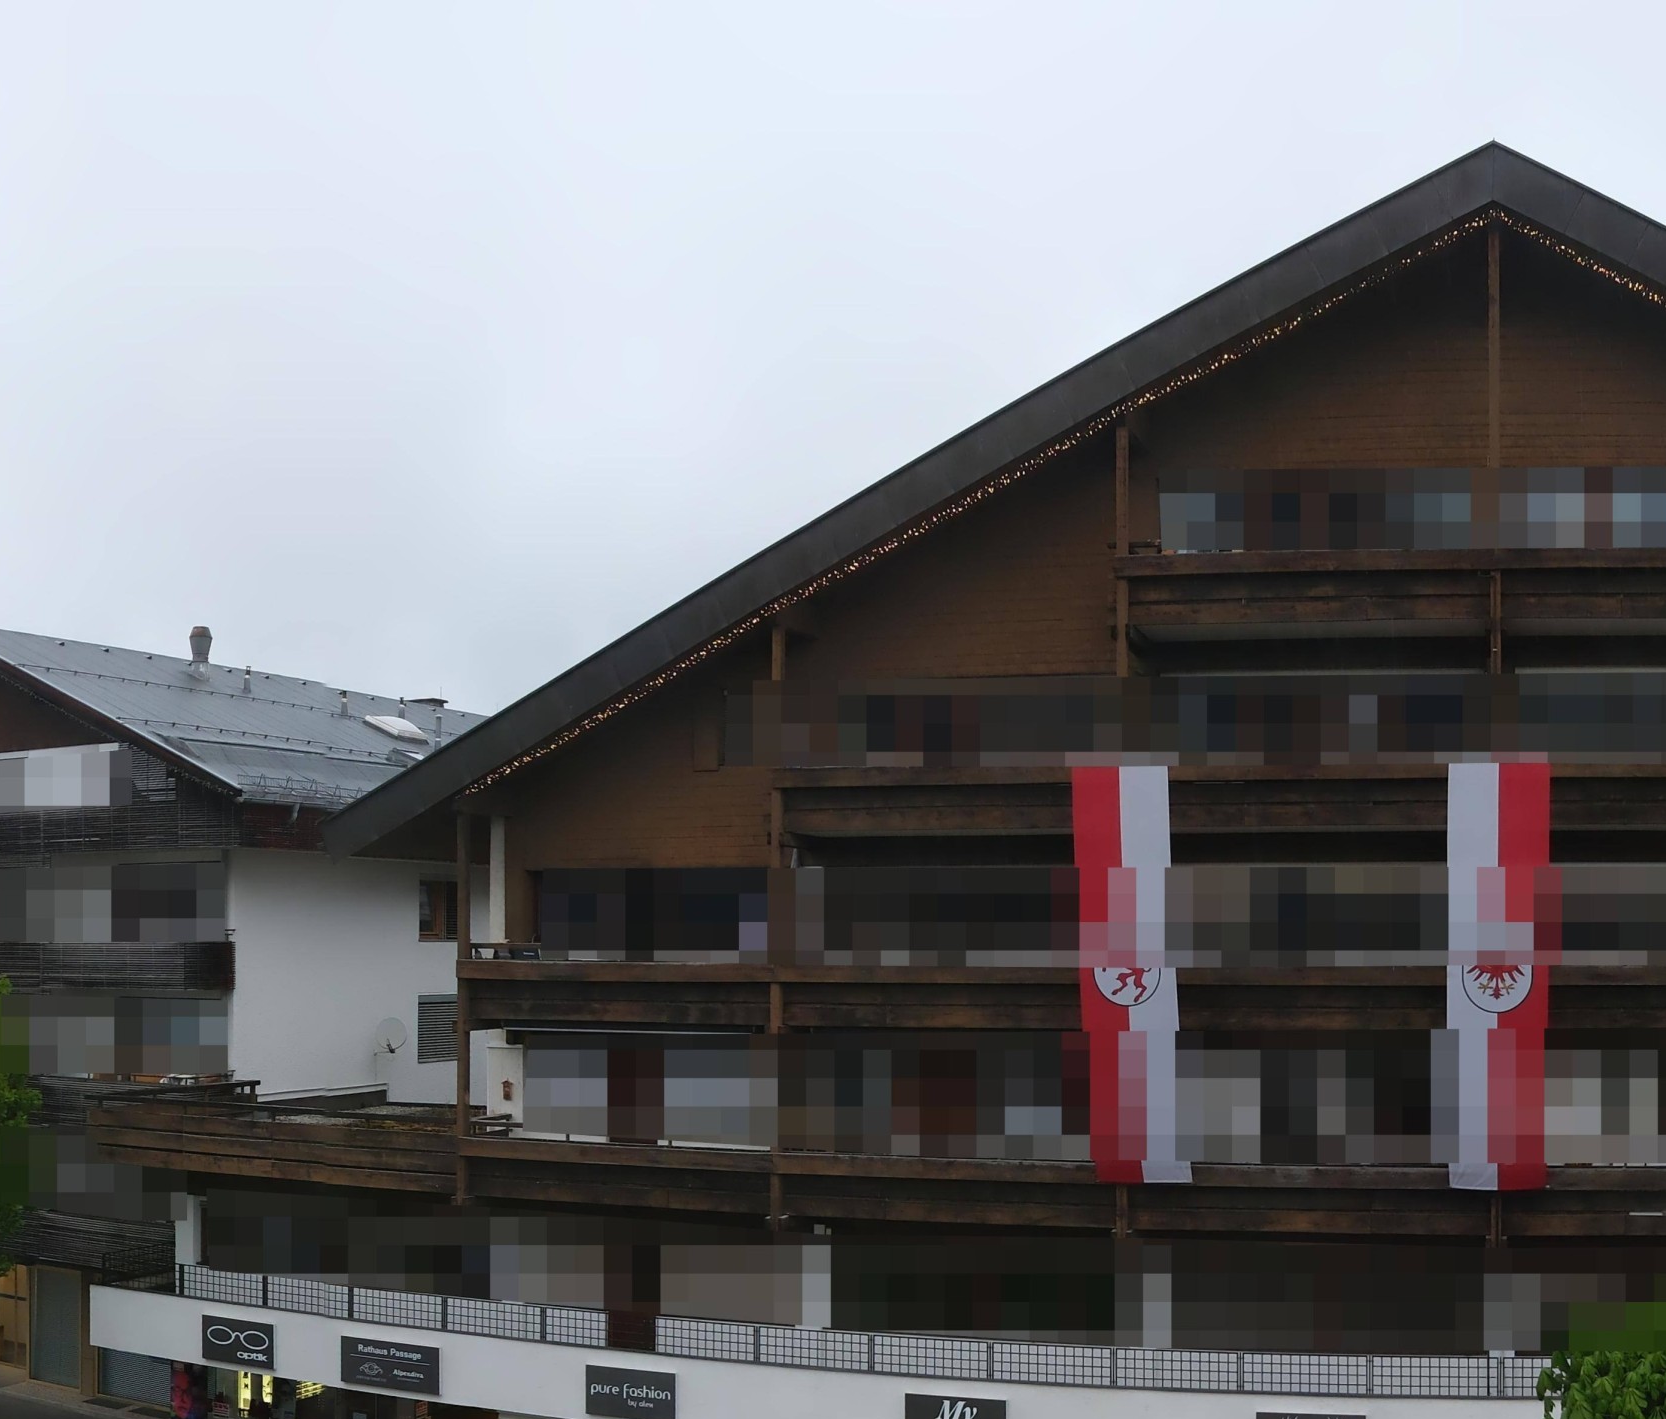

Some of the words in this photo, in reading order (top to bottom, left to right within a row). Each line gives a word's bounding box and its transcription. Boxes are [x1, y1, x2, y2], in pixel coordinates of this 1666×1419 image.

[357, 1343, 388, 1356] Rathaus
[390, 1347, 422, 1361] Passage
[590, 1383, 620, 1396] pure
[623, 1383, 671, 1400] fashion
[627, 1398, 637, 1408] by
